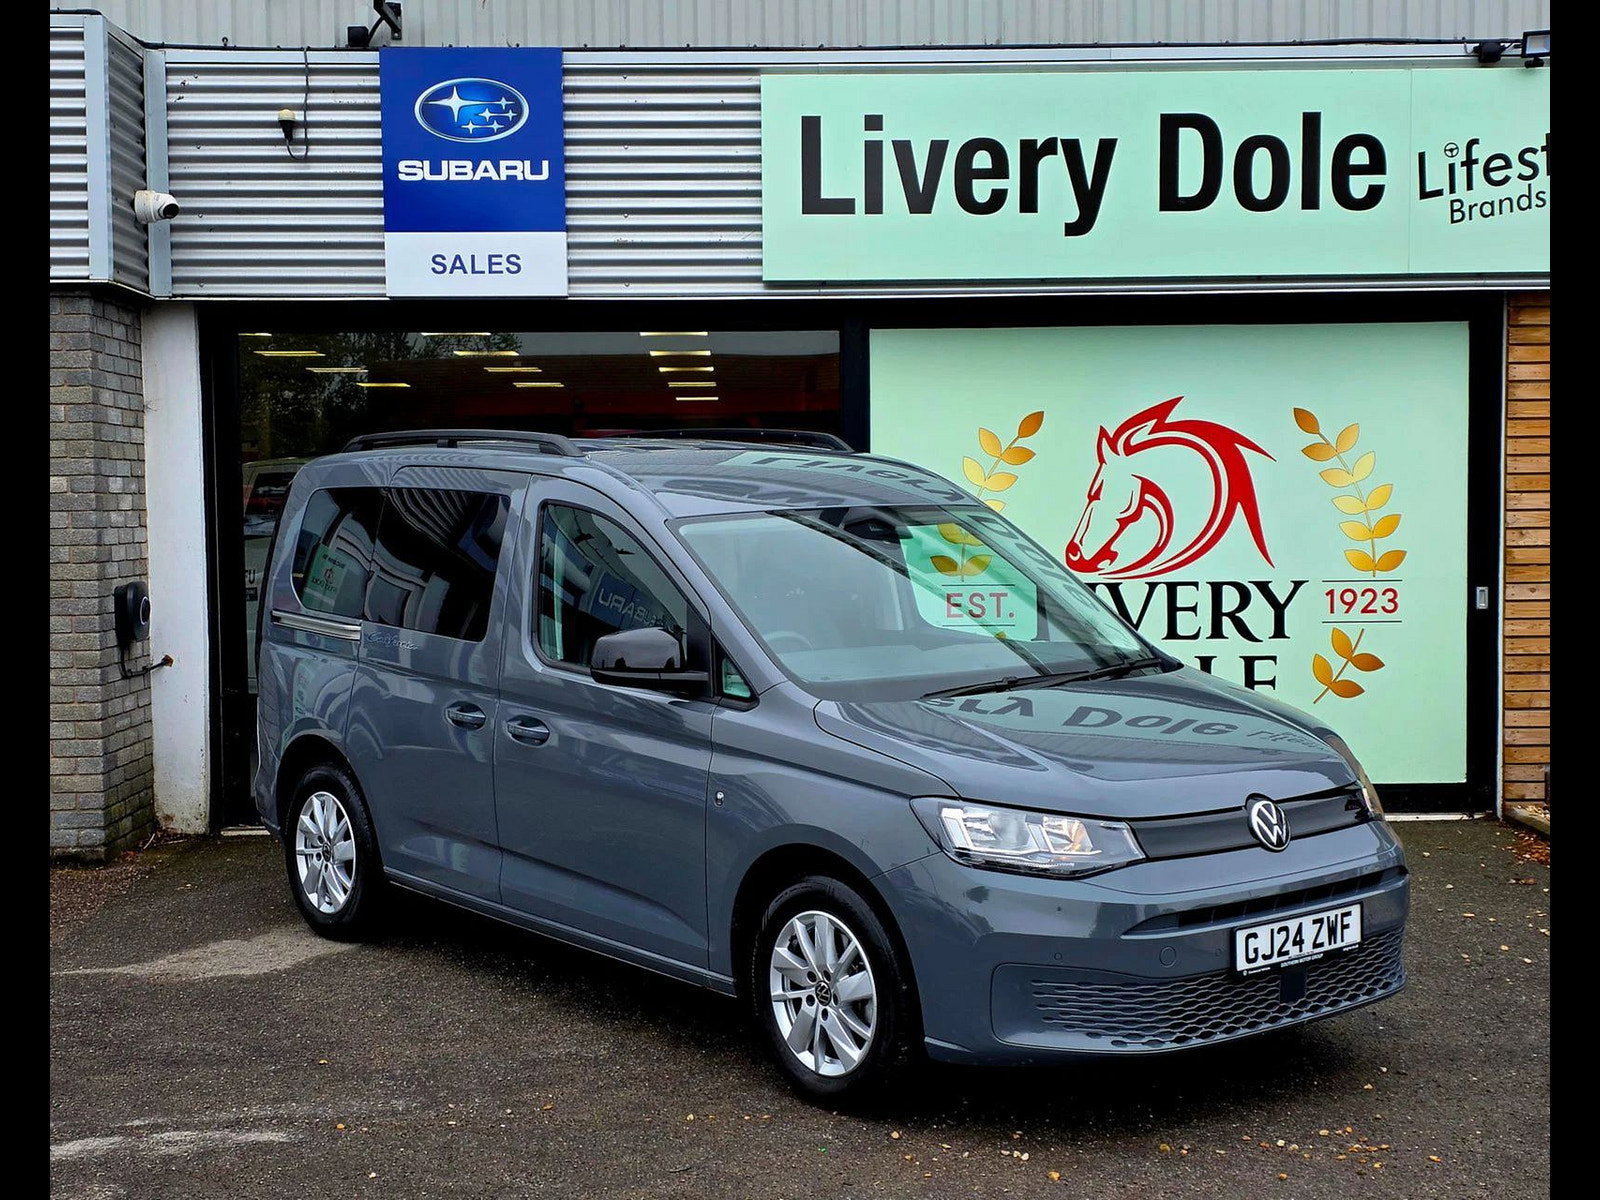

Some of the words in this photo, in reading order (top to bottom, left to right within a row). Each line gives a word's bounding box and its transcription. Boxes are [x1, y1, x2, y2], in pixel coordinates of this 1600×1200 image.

[398, 159, 550, 181] SUBARU
[800, 114, 1118, 237] Livery
[1158, 111, 1387, 213] Dole
[1450, 183, 1547, 224] Brands
[431, 253, 522, 275] SALES
[946, 592, 1015, 618] EST.
[1325, 587, 1400, 615] 1923
[1244, 921, 1305, 964] GJ24
[1312, 910, 1352, 950] ZWF
